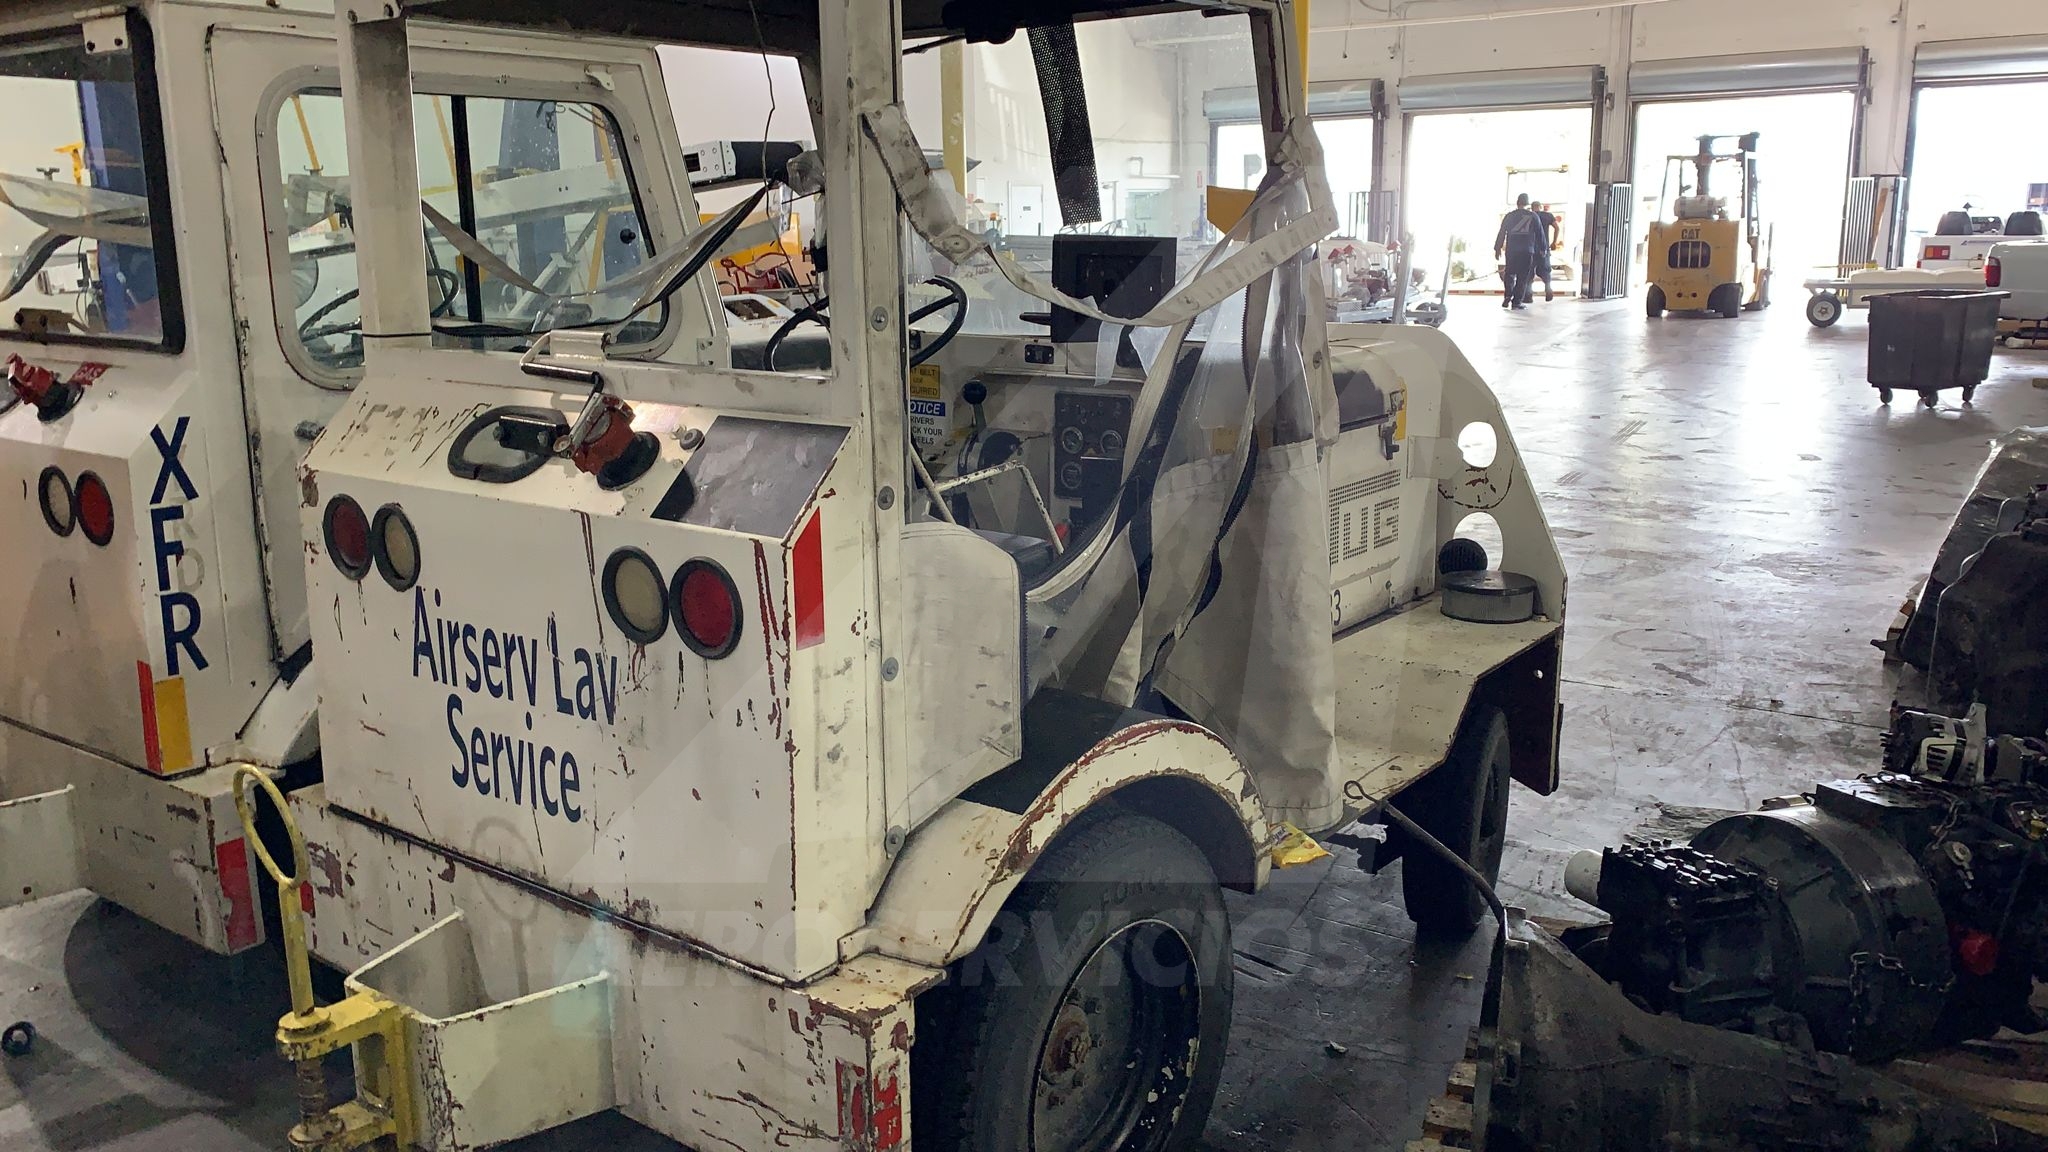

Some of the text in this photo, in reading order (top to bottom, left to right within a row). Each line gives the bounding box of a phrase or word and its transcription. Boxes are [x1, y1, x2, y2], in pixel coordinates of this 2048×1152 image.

[1681, 228, 1701, 240] CAT
[910, 401, 941, 415] OTICE
[910, 415, 935, 426] RIVERS
[923, 427, 943, 437] YOUR
[150, 415, 208, 676] XFR
[413, 585, 618, 726] Airserv Lav
[447, 693, 581, 823] Service
